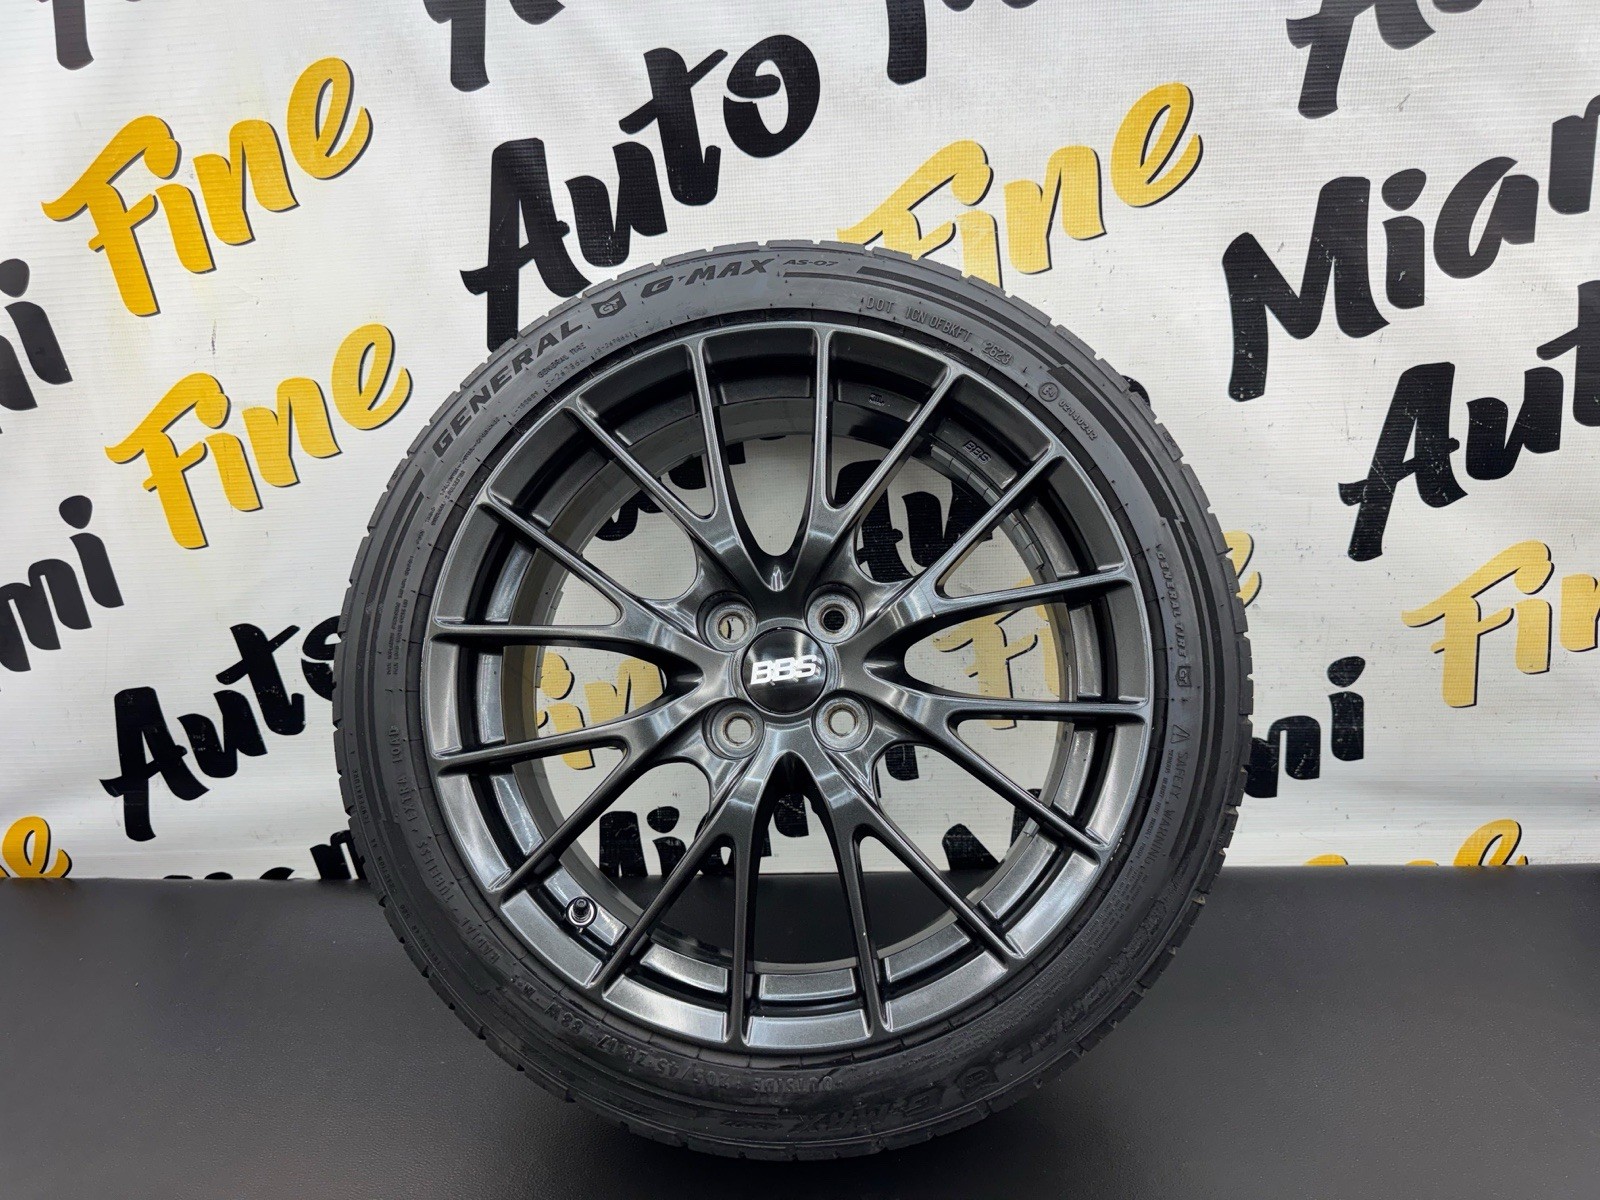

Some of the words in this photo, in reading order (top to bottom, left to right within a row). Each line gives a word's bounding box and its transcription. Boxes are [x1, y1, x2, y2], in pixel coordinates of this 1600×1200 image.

[41, 57, 374, 317] Fine
[459, 34, 821, 353] Auto
[431, 320, 584, 458] GENERAL
[782, 258, 839, 267] AS-07
[866, 296, 894, 313] DOT
[980, 341, 1013, 366] 2623
[108, 324, 413, 550] Fine
[962, 439, 992, 465] BBS
[1157, 552, 1182, 618] GENERAL
[1173, 621, 1187, 658] TIRE
[750, 654, 820, 685] BBS
[387, 723, 403, 765] LOAD
[1168, 749, 1188, 799] SAFETY
[395, 773, 418, 822] EXTRA
[1143, 806, 1175, 868] WARNING
[415, 837, 455, 904] TUBELESS
[542, 997, 586, 1037] 88W
